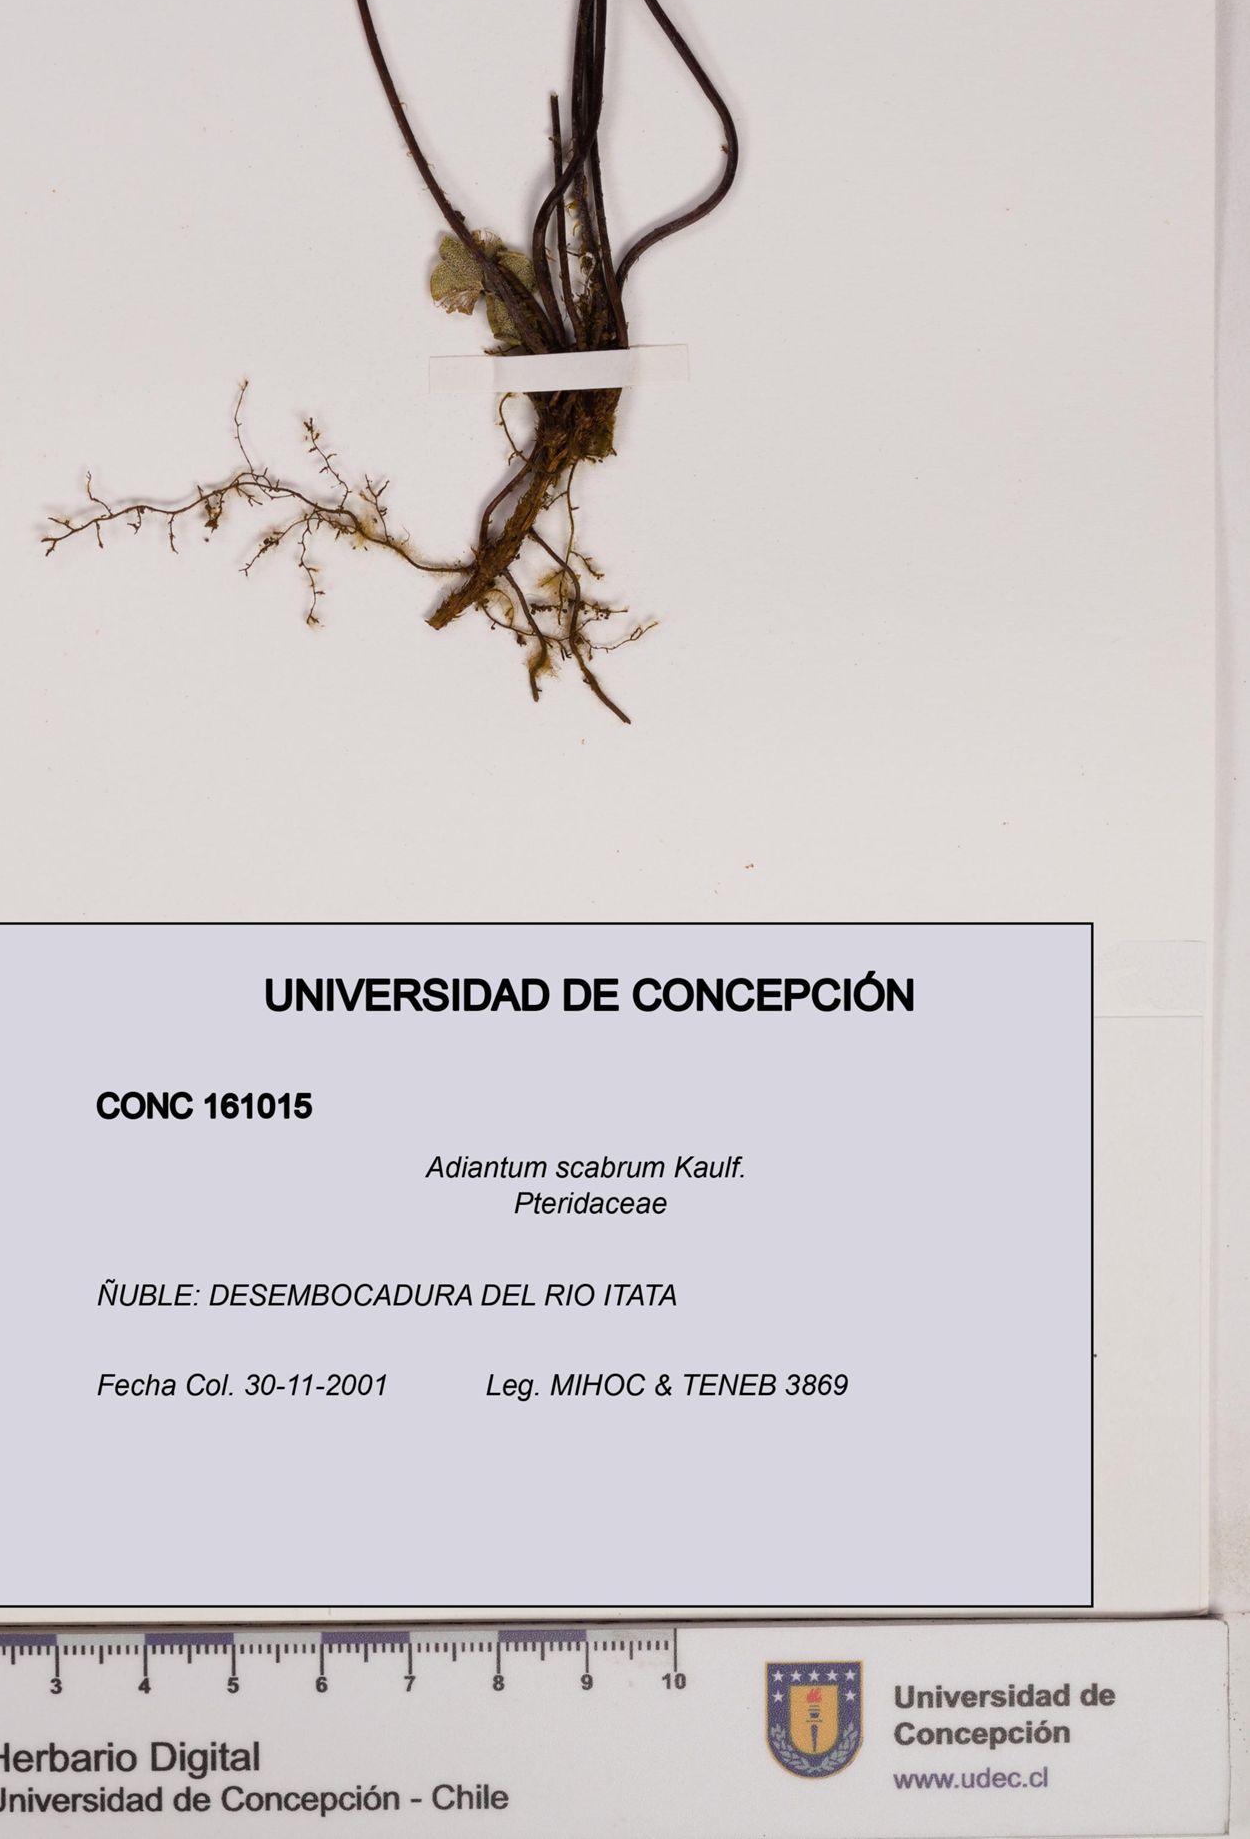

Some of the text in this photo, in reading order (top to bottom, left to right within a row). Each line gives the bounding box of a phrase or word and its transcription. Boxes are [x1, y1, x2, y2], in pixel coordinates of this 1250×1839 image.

[49, 1677, 63, 1695] 3
[137, 1675, 152, 1695] 4
[226, 1675, 240, 1694] 5
[315, 1675, 329, 1694] 6
[403, 1673, 417, 1693] 7
[492, 1674, 506, 1692] 8
[580, 1673, 594, 1691] 9
[661, 1672, 687, 1690] 10
[894, 1682, 1116, 1710] Universidad de
[893, 1719, 1071, 1751] Concepción
[150, 1740, 260, 1779] Digital
[892, 1766, 1049, 1790] www.udec.cl
[172, 1785, 211, 1813] de
[220, 1784, 400, 1818] Concepción
[431, 1783, 510, 1811] Chile
